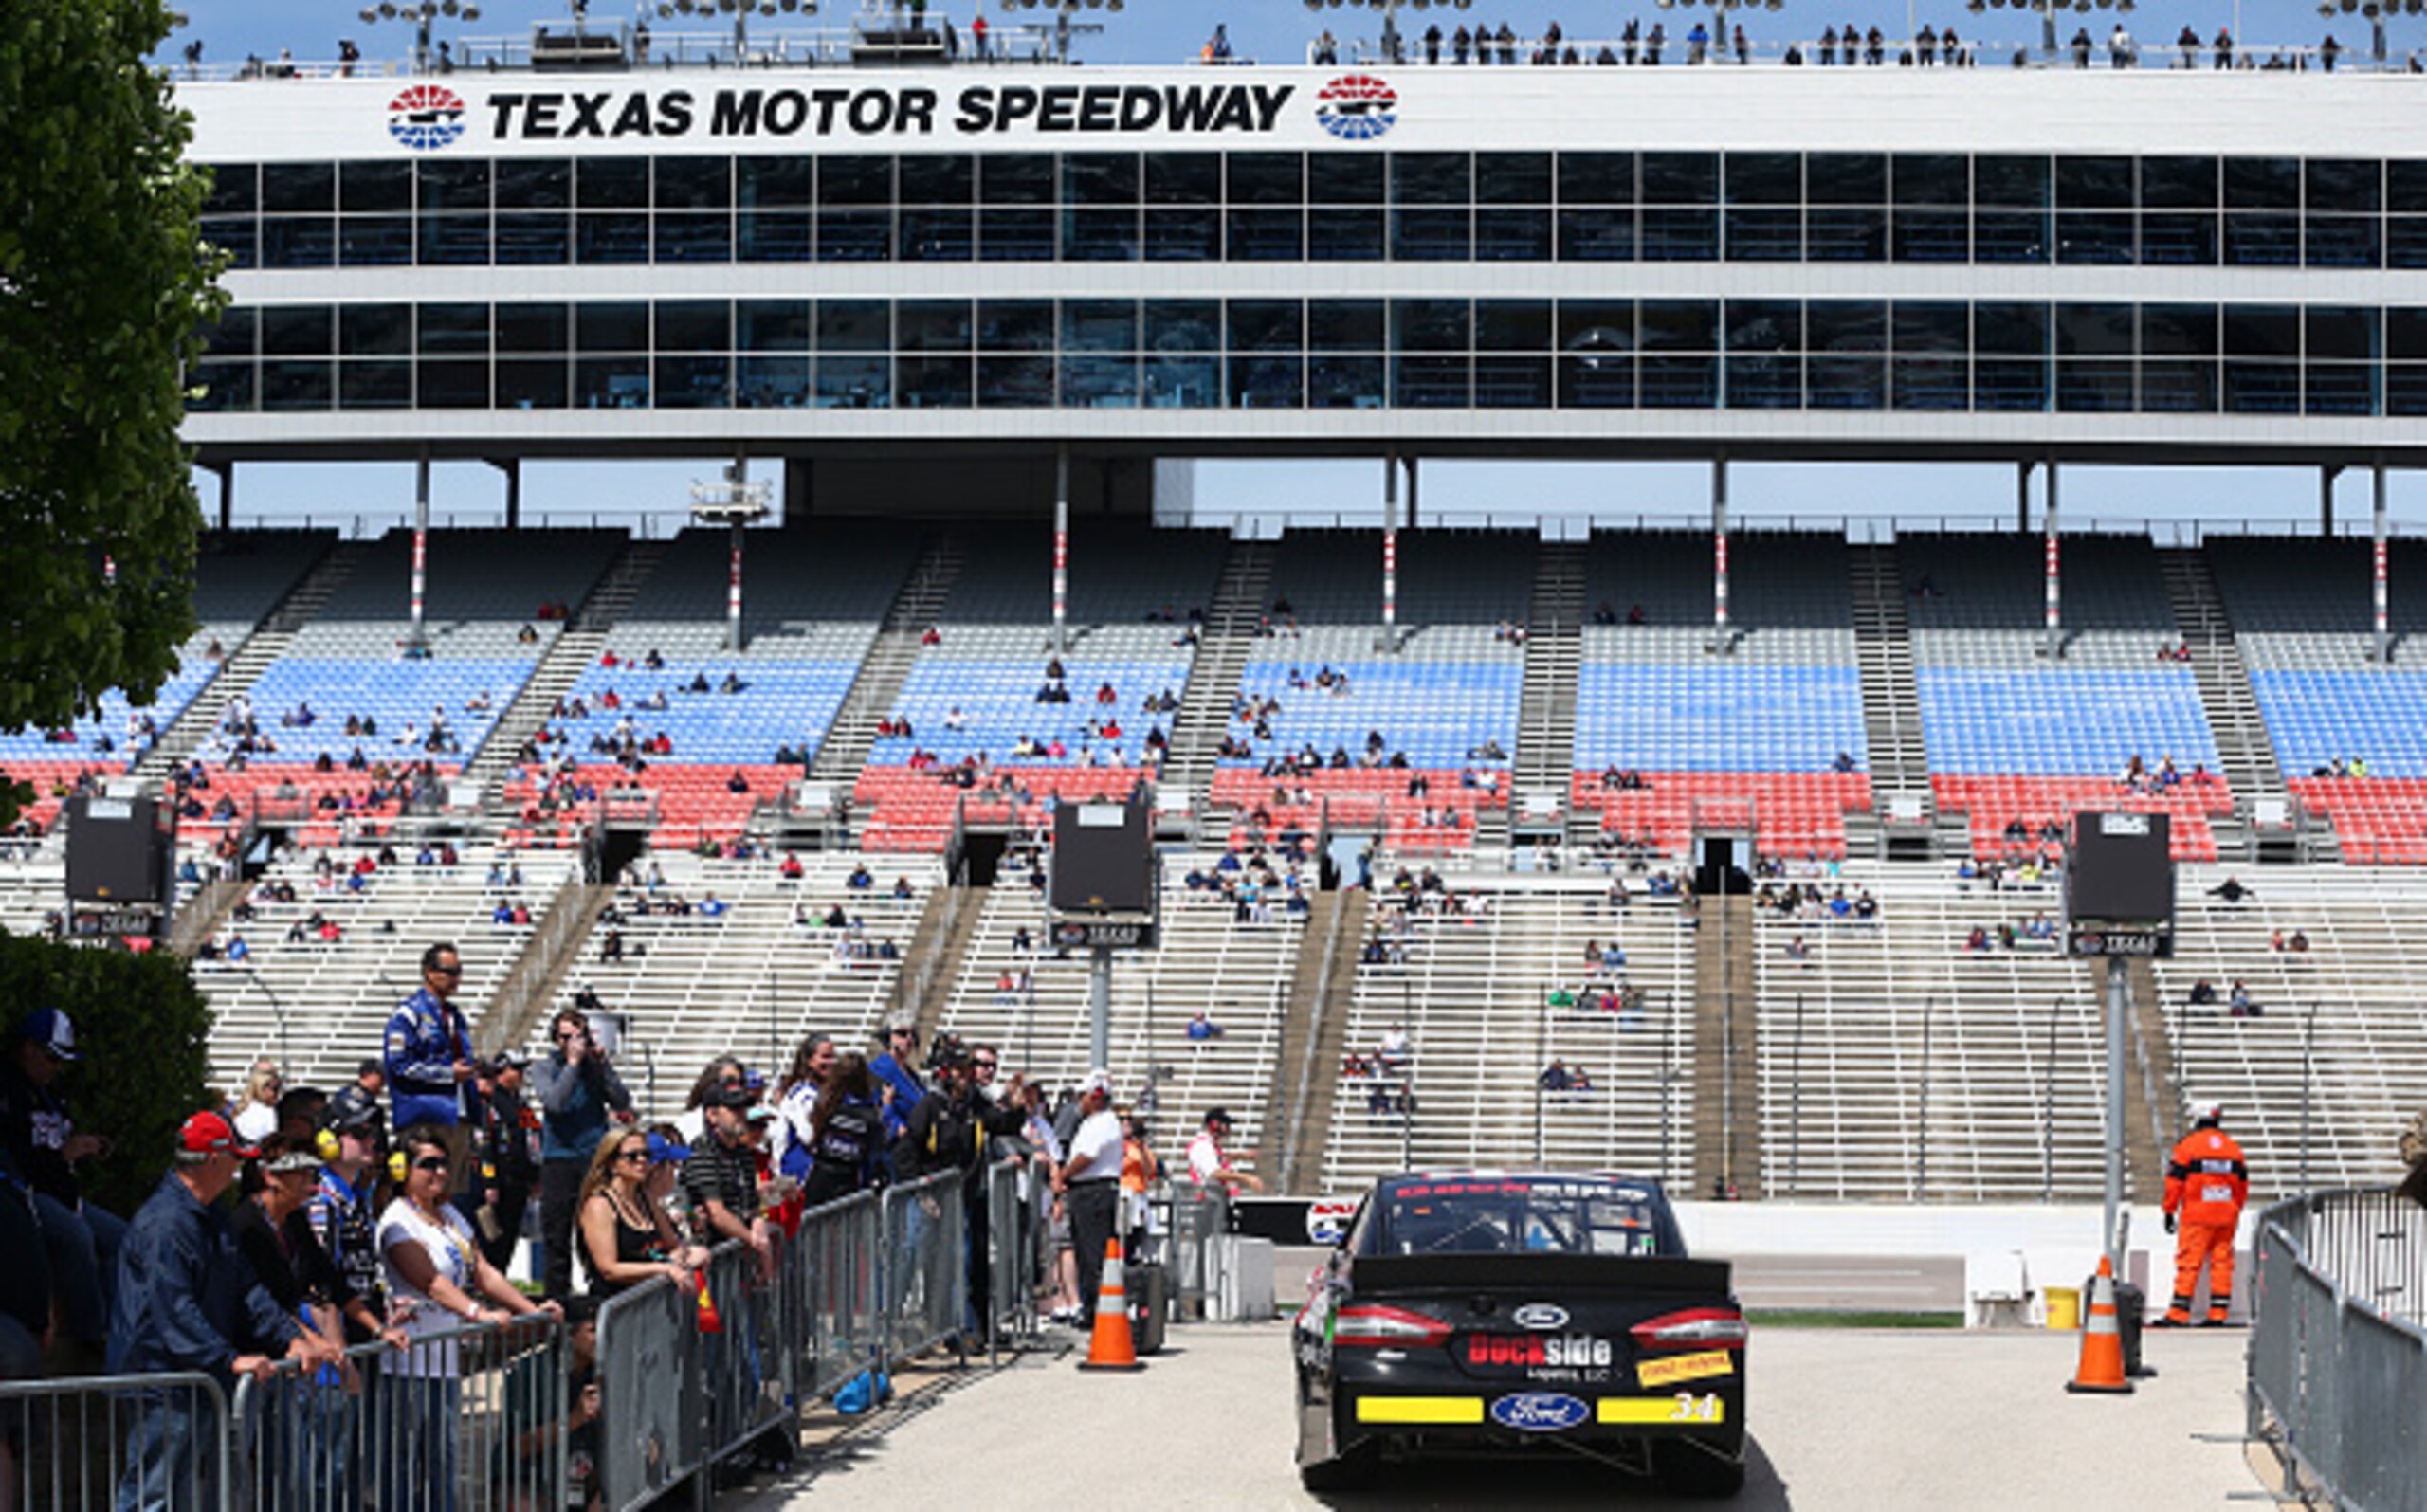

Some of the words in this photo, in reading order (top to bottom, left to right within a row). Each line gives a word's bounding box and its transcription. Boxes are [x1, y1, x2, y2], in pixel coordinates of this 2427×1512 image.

[488, 91, 692, 139] TEXAS
[710, 89, 937, 136] MOTOR
[955, 85, 1295, 134] SPEEDWAY
[1509, 1396, 1571, 1423] Ford
[1670, 1392, 1716, 1422] 34
